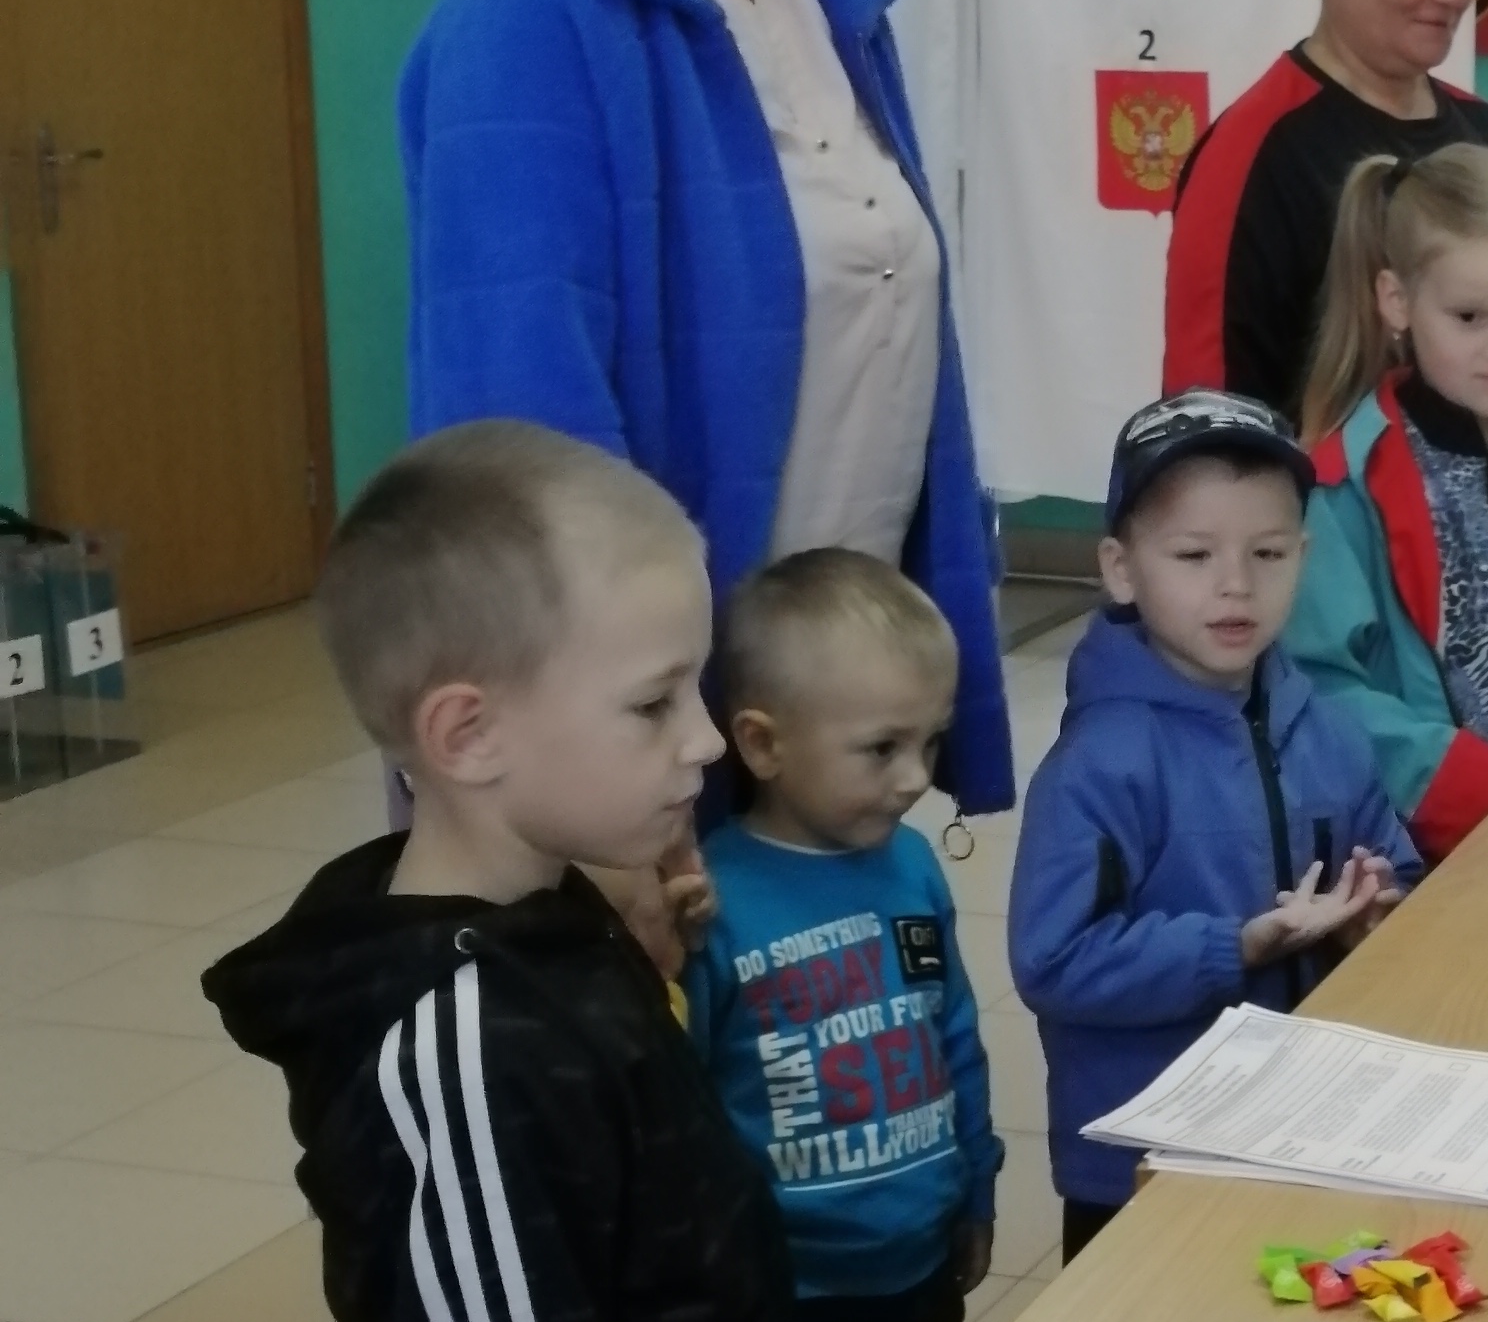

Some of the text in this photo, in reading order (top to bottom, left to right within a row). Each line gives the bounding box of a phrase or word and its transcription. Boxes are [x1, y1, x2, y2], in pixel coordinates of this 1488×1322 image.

[1138, 29, 1156, 60] 2
[9, 653, 24, 685] 2
[734, 948, 766, 983] DO
[769, 912, 883, 969] SOMETHING
[743, 939, 885, 1031] TODAY
[813, 1002, 884, 1049] YOUR
[757, 1032, 823, 1137] THAT
[767, 1123, 893, 1182] WILL
